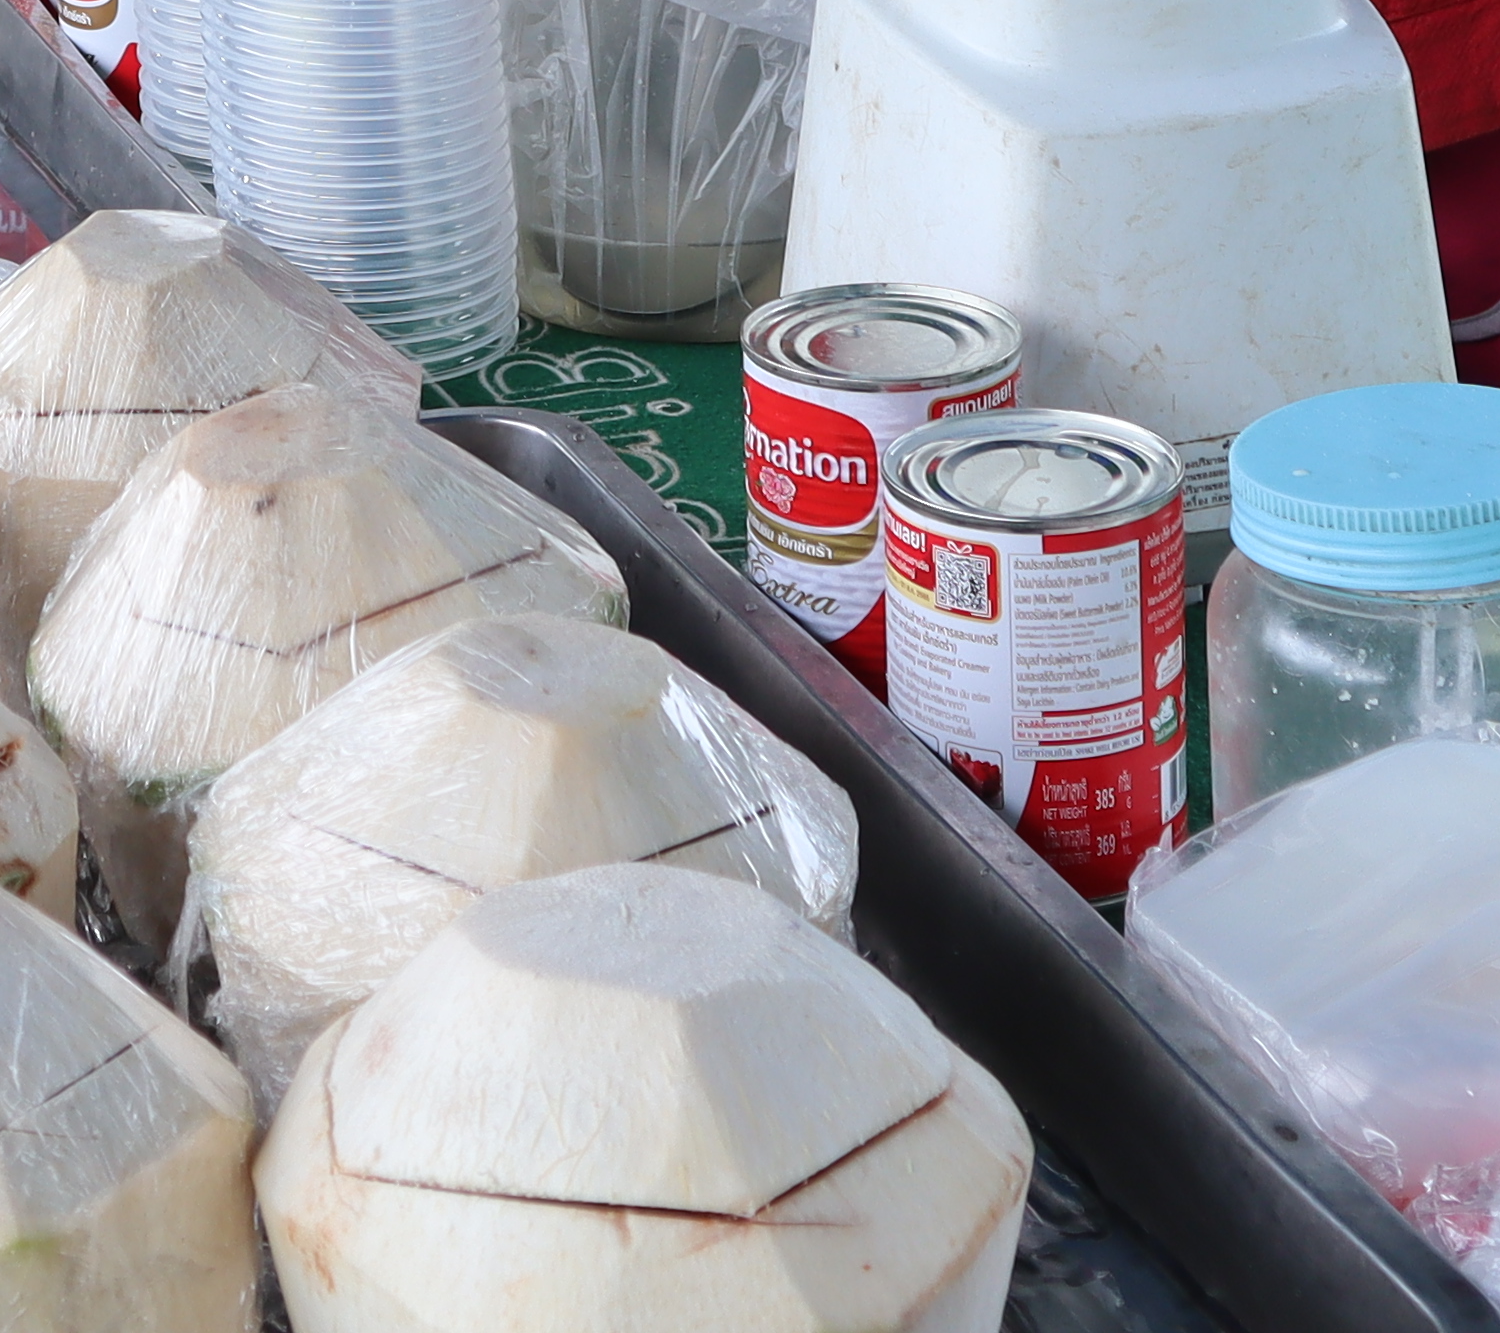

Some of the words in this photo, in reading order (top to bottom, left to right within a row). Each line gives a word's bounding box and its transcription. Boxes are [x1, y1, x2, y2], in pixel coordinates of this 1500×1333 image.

[749, 542, 840, 616] Extra
[1113, 712, 1122, 721] 12
[1095, 787, 1115, 811] 385
[1043, 808, 1057, 820] NET
[1059, 805, 1088, 819] WEIGHT
[1096, 834, 1116, 856] 369
